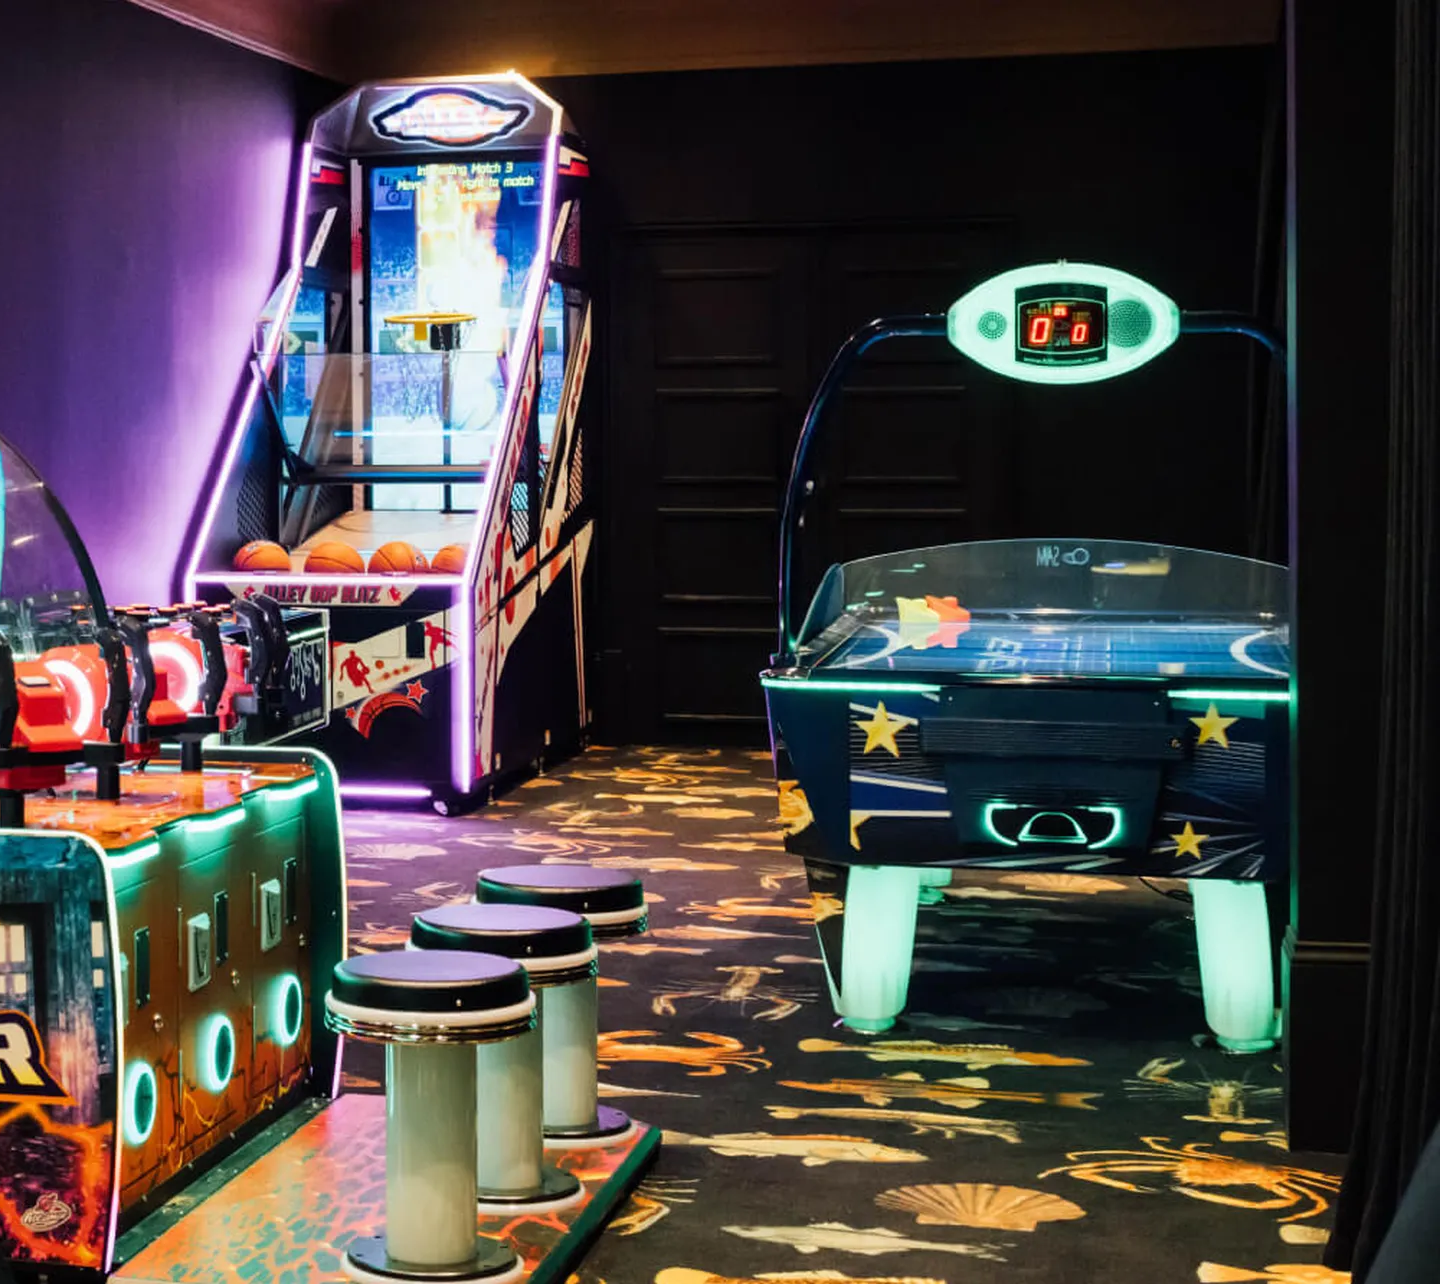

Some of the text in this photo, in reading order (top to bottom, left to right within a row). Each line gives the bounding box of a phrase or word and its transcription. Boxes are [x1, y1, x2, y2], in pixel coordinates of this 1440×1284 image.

[503, 175, 535, 187] match
[1029, 317, 1050, 343] 0
[1072, 323, 1087, 342] 0
